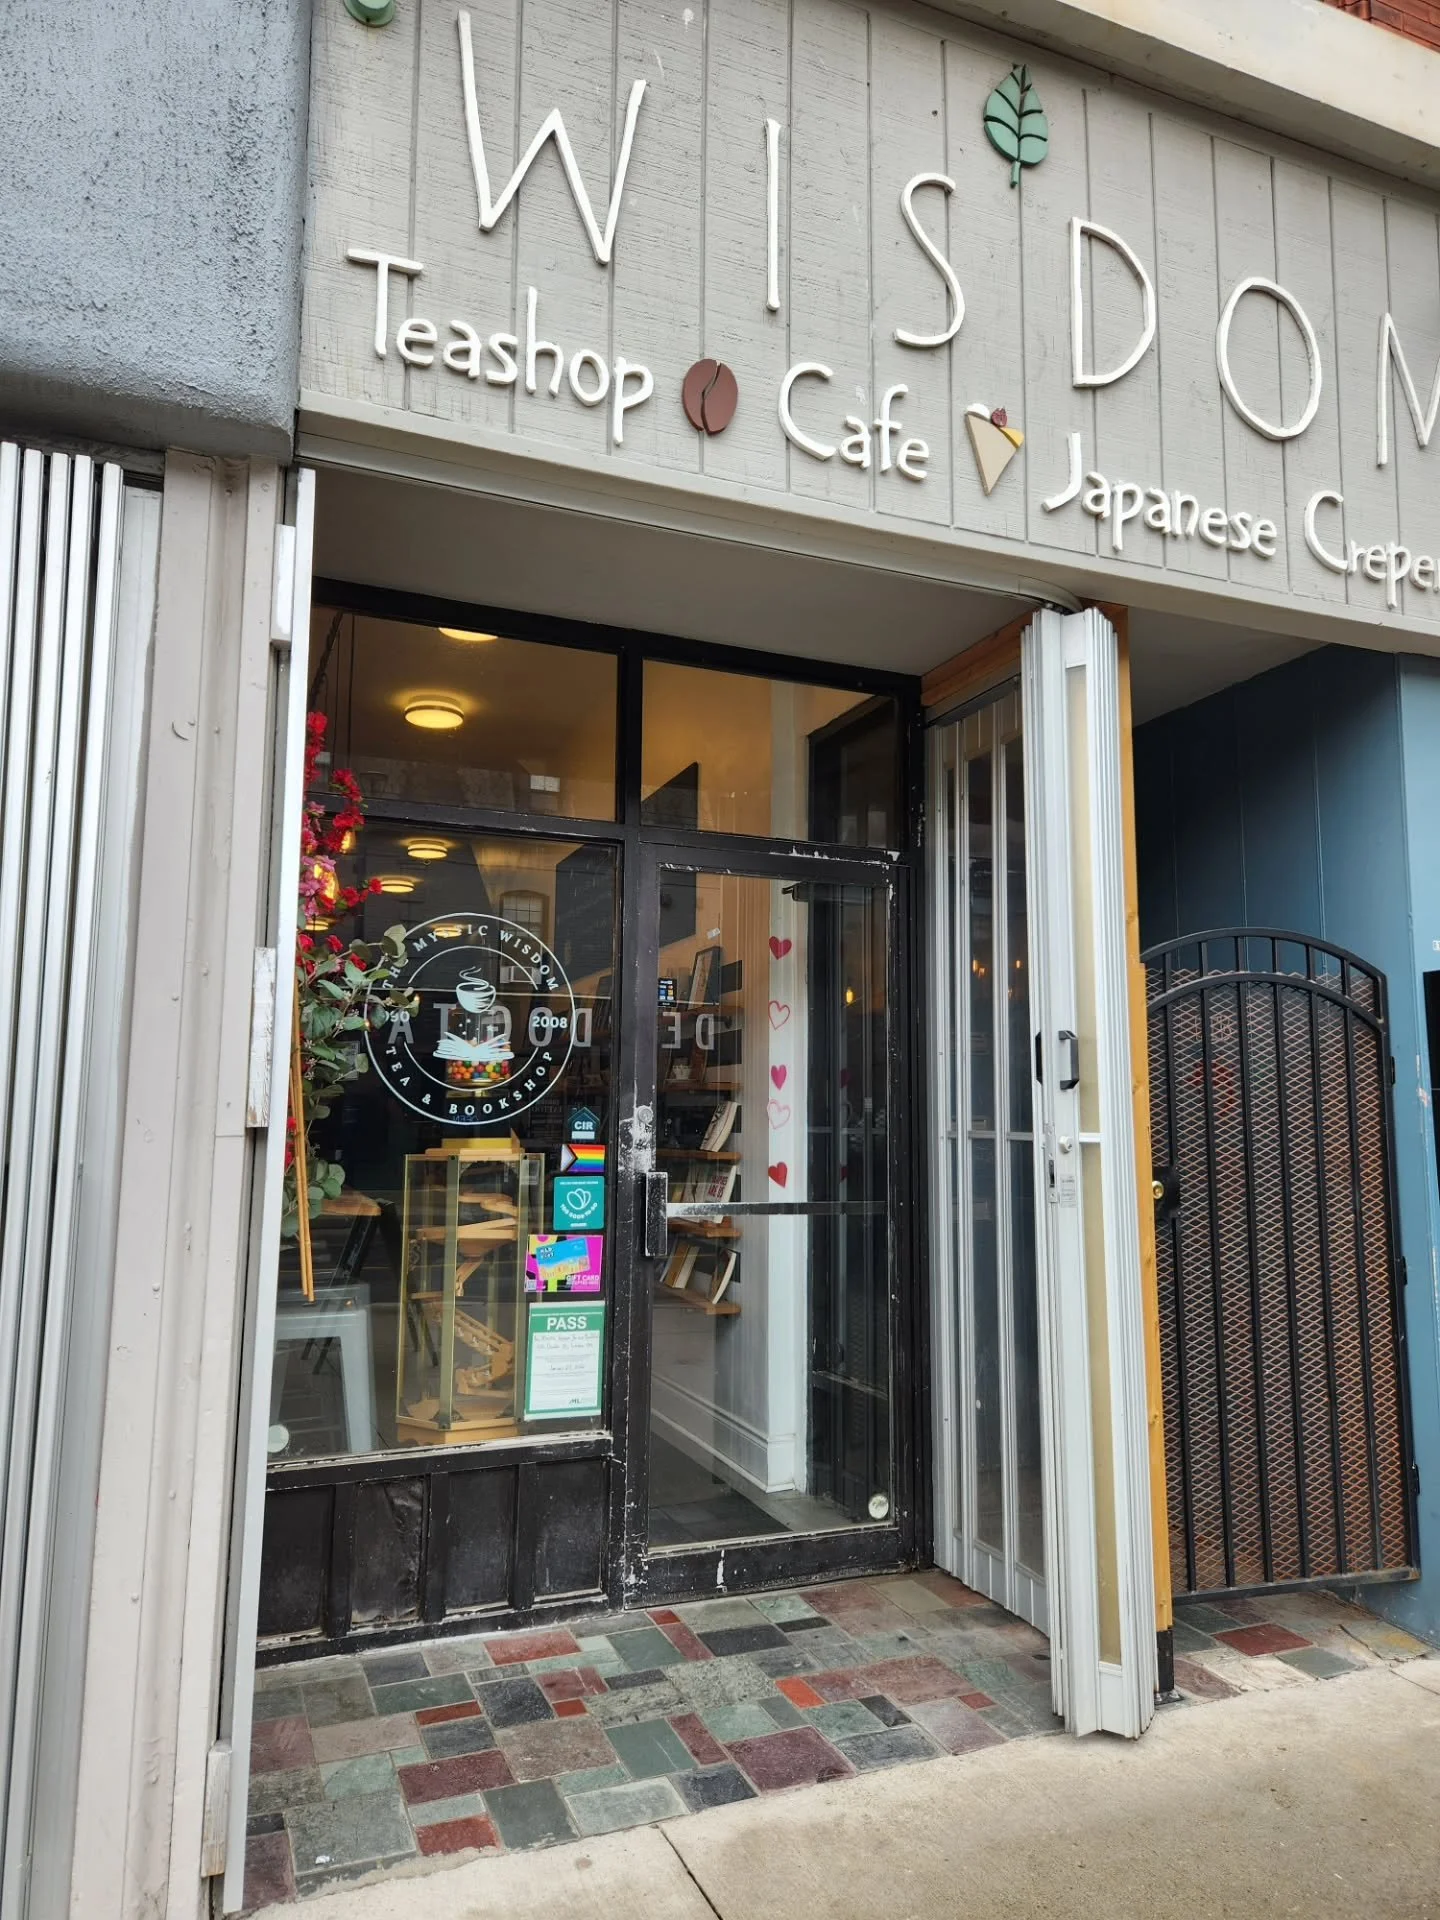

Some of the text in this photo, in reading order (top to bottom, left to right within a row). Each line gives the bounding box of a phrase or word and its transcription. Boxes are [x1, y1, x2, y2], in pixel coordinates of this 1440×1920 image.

[457, 10, 1440, 467] WISDOM
[346, 249, 655, 445] Teashop
[778, 361, 930, 480] Cafe
[1042, 433, 1278, 558] Japanese
[383, 924, 559, 991] TH MYIC WISDOM
[532, 1016, 568, 1029] 2008
[385, 1046, 552, 1116] TEA & BOOKSHOP
[574, 1120, 594, 1130] CIR
[547, 1315, 588, 1331] PASS
